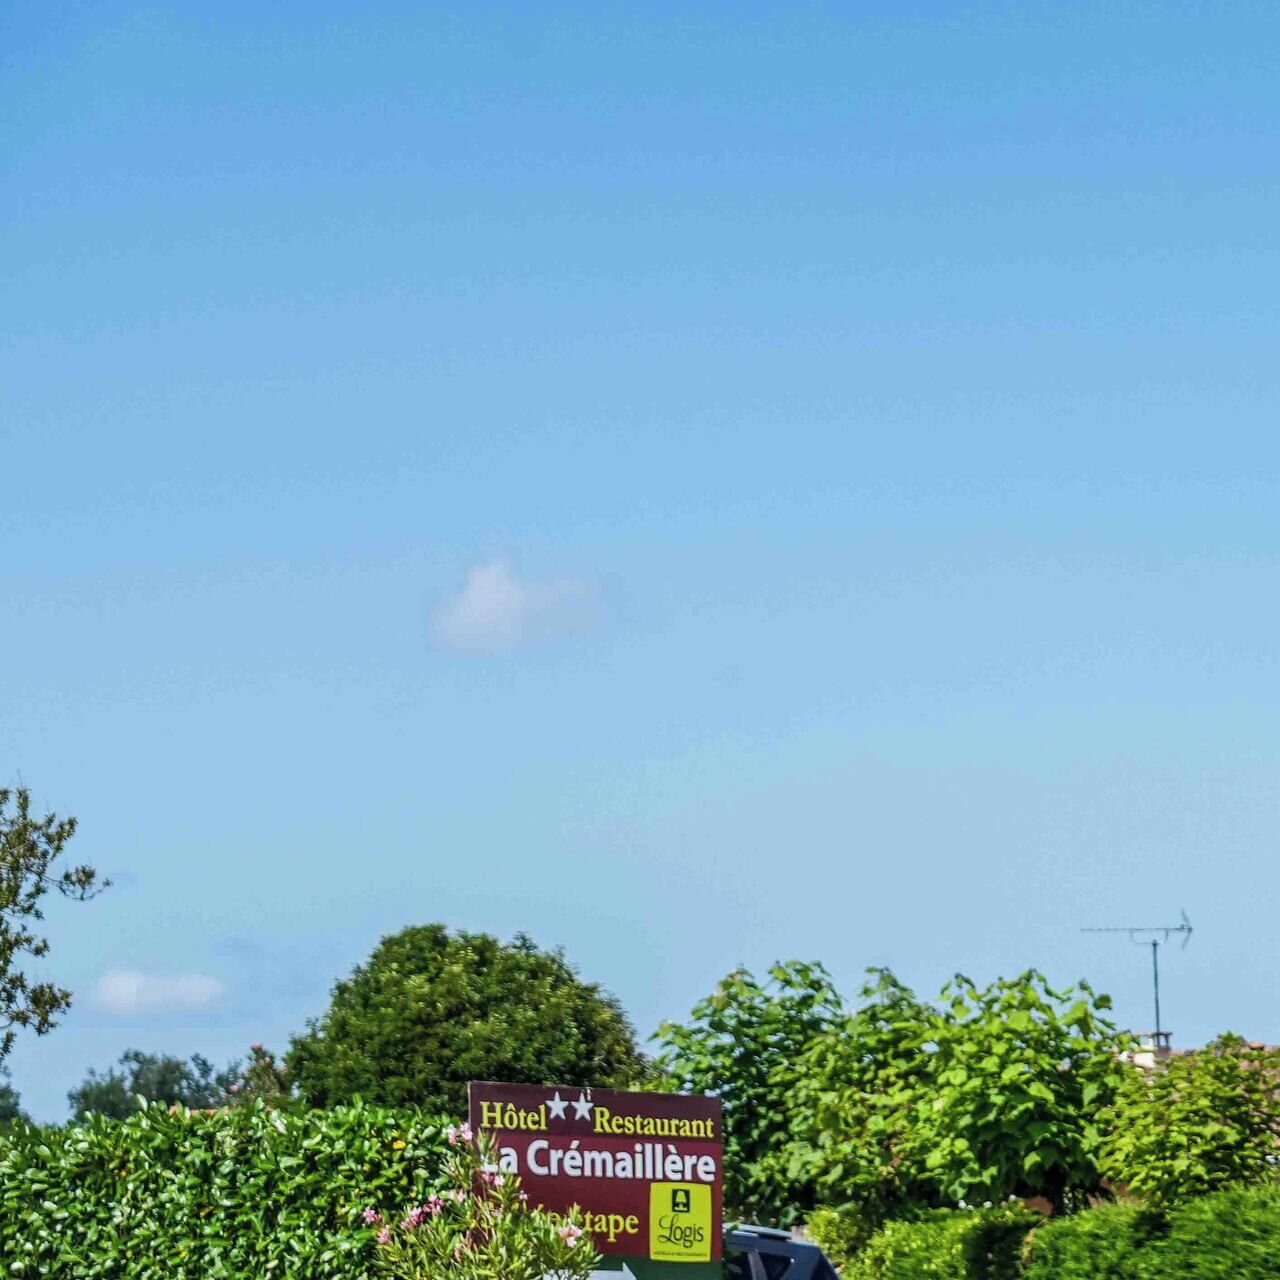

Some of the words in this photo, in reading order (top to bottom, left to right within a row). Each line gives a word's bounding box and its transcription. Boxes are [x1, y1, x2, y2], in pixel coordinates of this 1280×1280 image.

[480, 1101, 548, 1131] Hôtel
[593, 1106, 714, 1138] Restaurant
[526, 1139, 717, 1182] Crémaillère
[582, 1210, 639, 1244] tape
[656, 1213, 705, 1248] Logis
